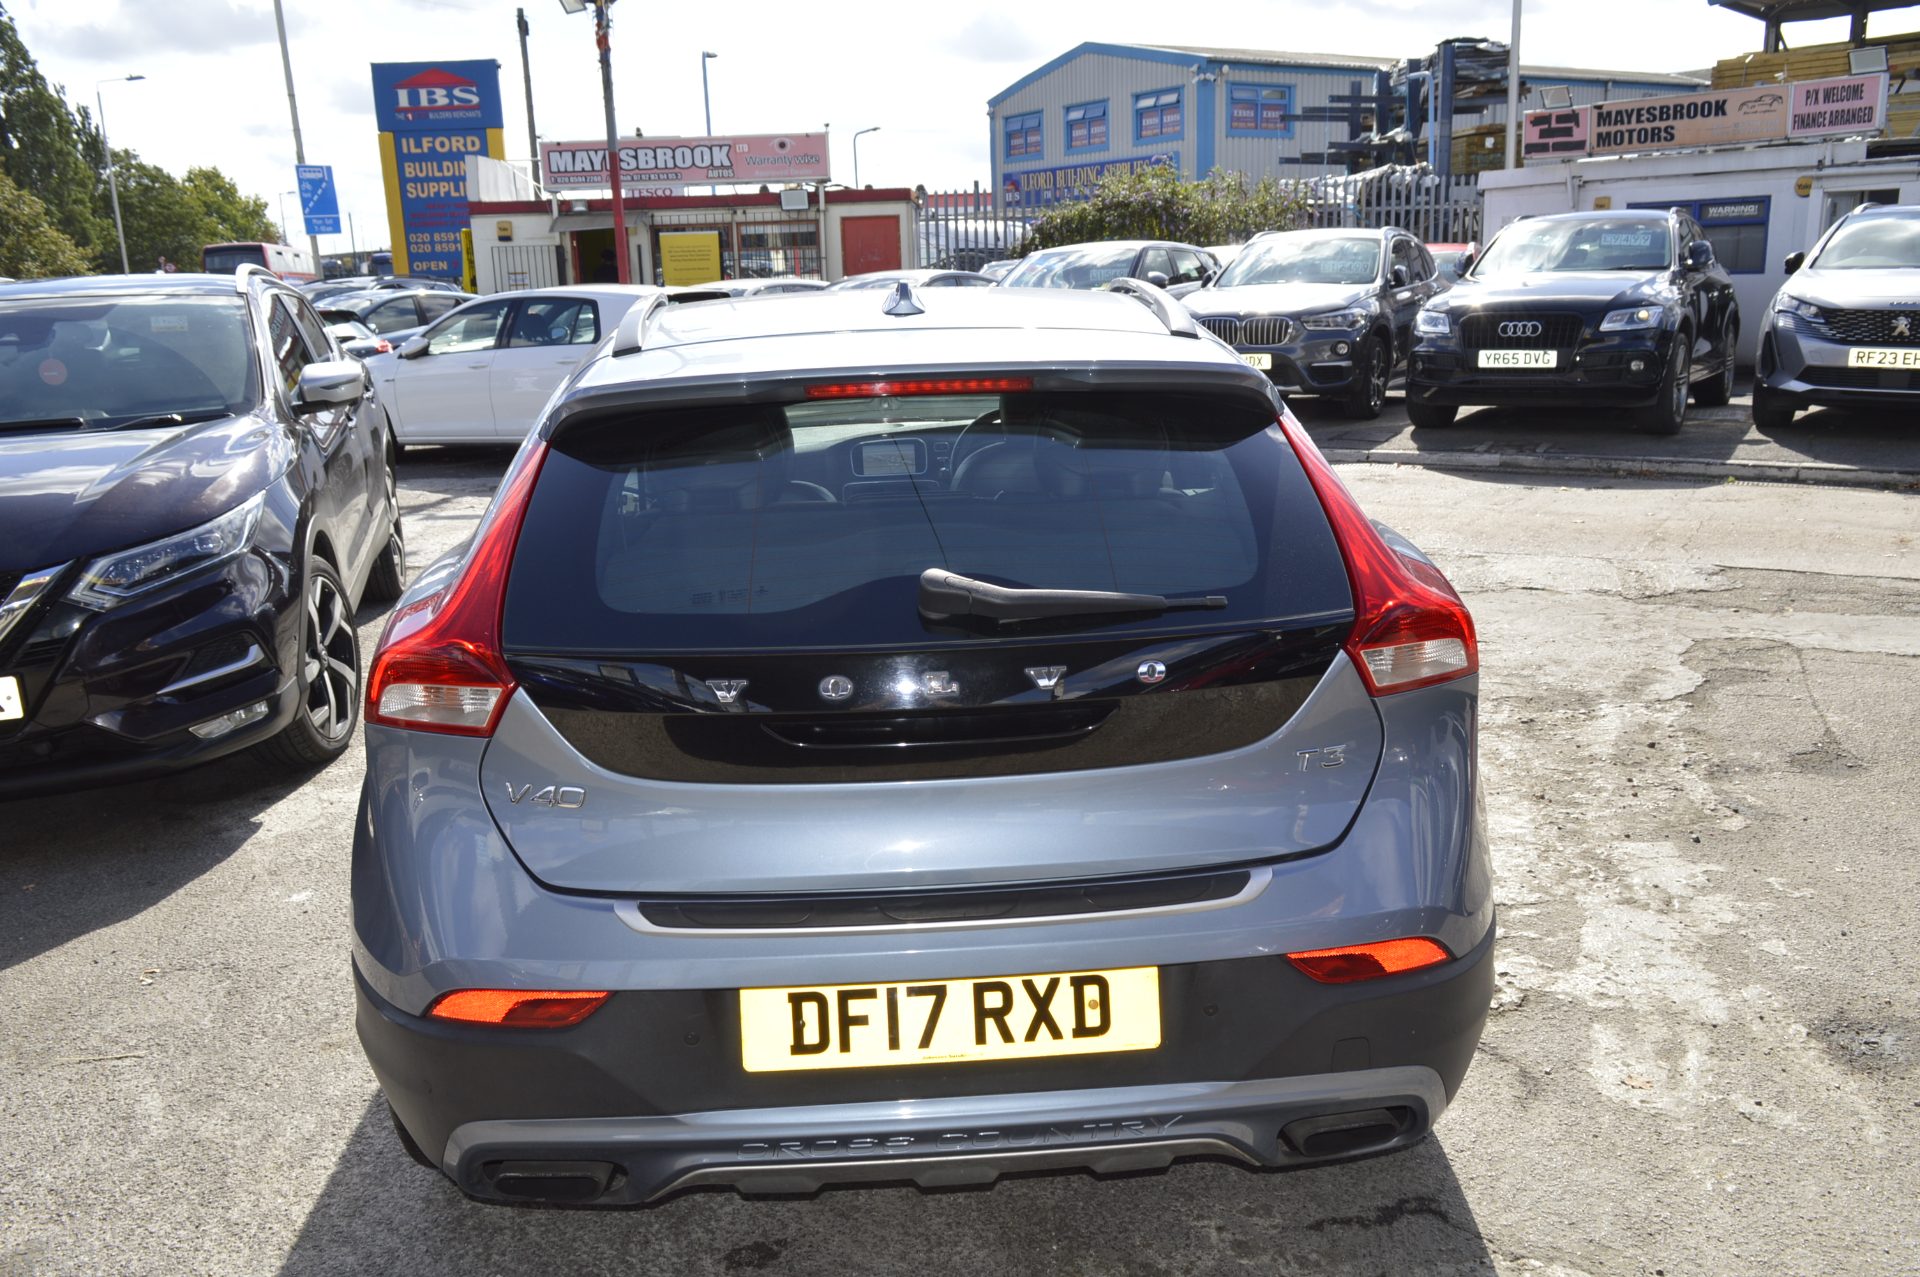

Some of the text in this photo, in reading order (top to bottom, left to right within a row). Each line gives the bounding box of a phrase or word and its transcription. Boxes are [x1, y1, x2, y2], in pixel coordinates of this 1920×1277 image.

[396, 86, 480, 107] IBS
[1805, 83, 1864, 106] P/X WELCOME
[1596, 99, 1728, 127] MAYESBROOK
[1793, 110, 1827, 130] FINANCE
[1828, 106, 1873, 127] ARRANGED
[401, 136, 481, 154] ILFORD
[1596, 125, 1675, 148] MOTORS
[404, 161, 466, 178] BUILDIN
[707, 168, 735, 179] AUTOS
[1021, 171, 1054, 191] ILFORD
[1056, 165, 1100, 188] BUILDING
[407, 182, 465, 198] SUPPLI
[629, 187, 673, 197] TESCO
[1708, 204, 1759, 214] WARNING!
[409, 232, 460, 242] 020 8591
[410, 243, 461, 252] 020 8591
[413, 260, 448, 271] OPEN
[1485, 351, 1550, 365] YR65 DVG
[1856, 351, 1898, 365] RF23
[705, 659, 1168, 704] VOLVO
[1296, 744, 1347, 772] T3
[505, 781, 586, 809] V40
[787, 974, 1112, 1056] DF17 RXD
[738, 1115, 1184, 1160] CROSS COUNTRY
